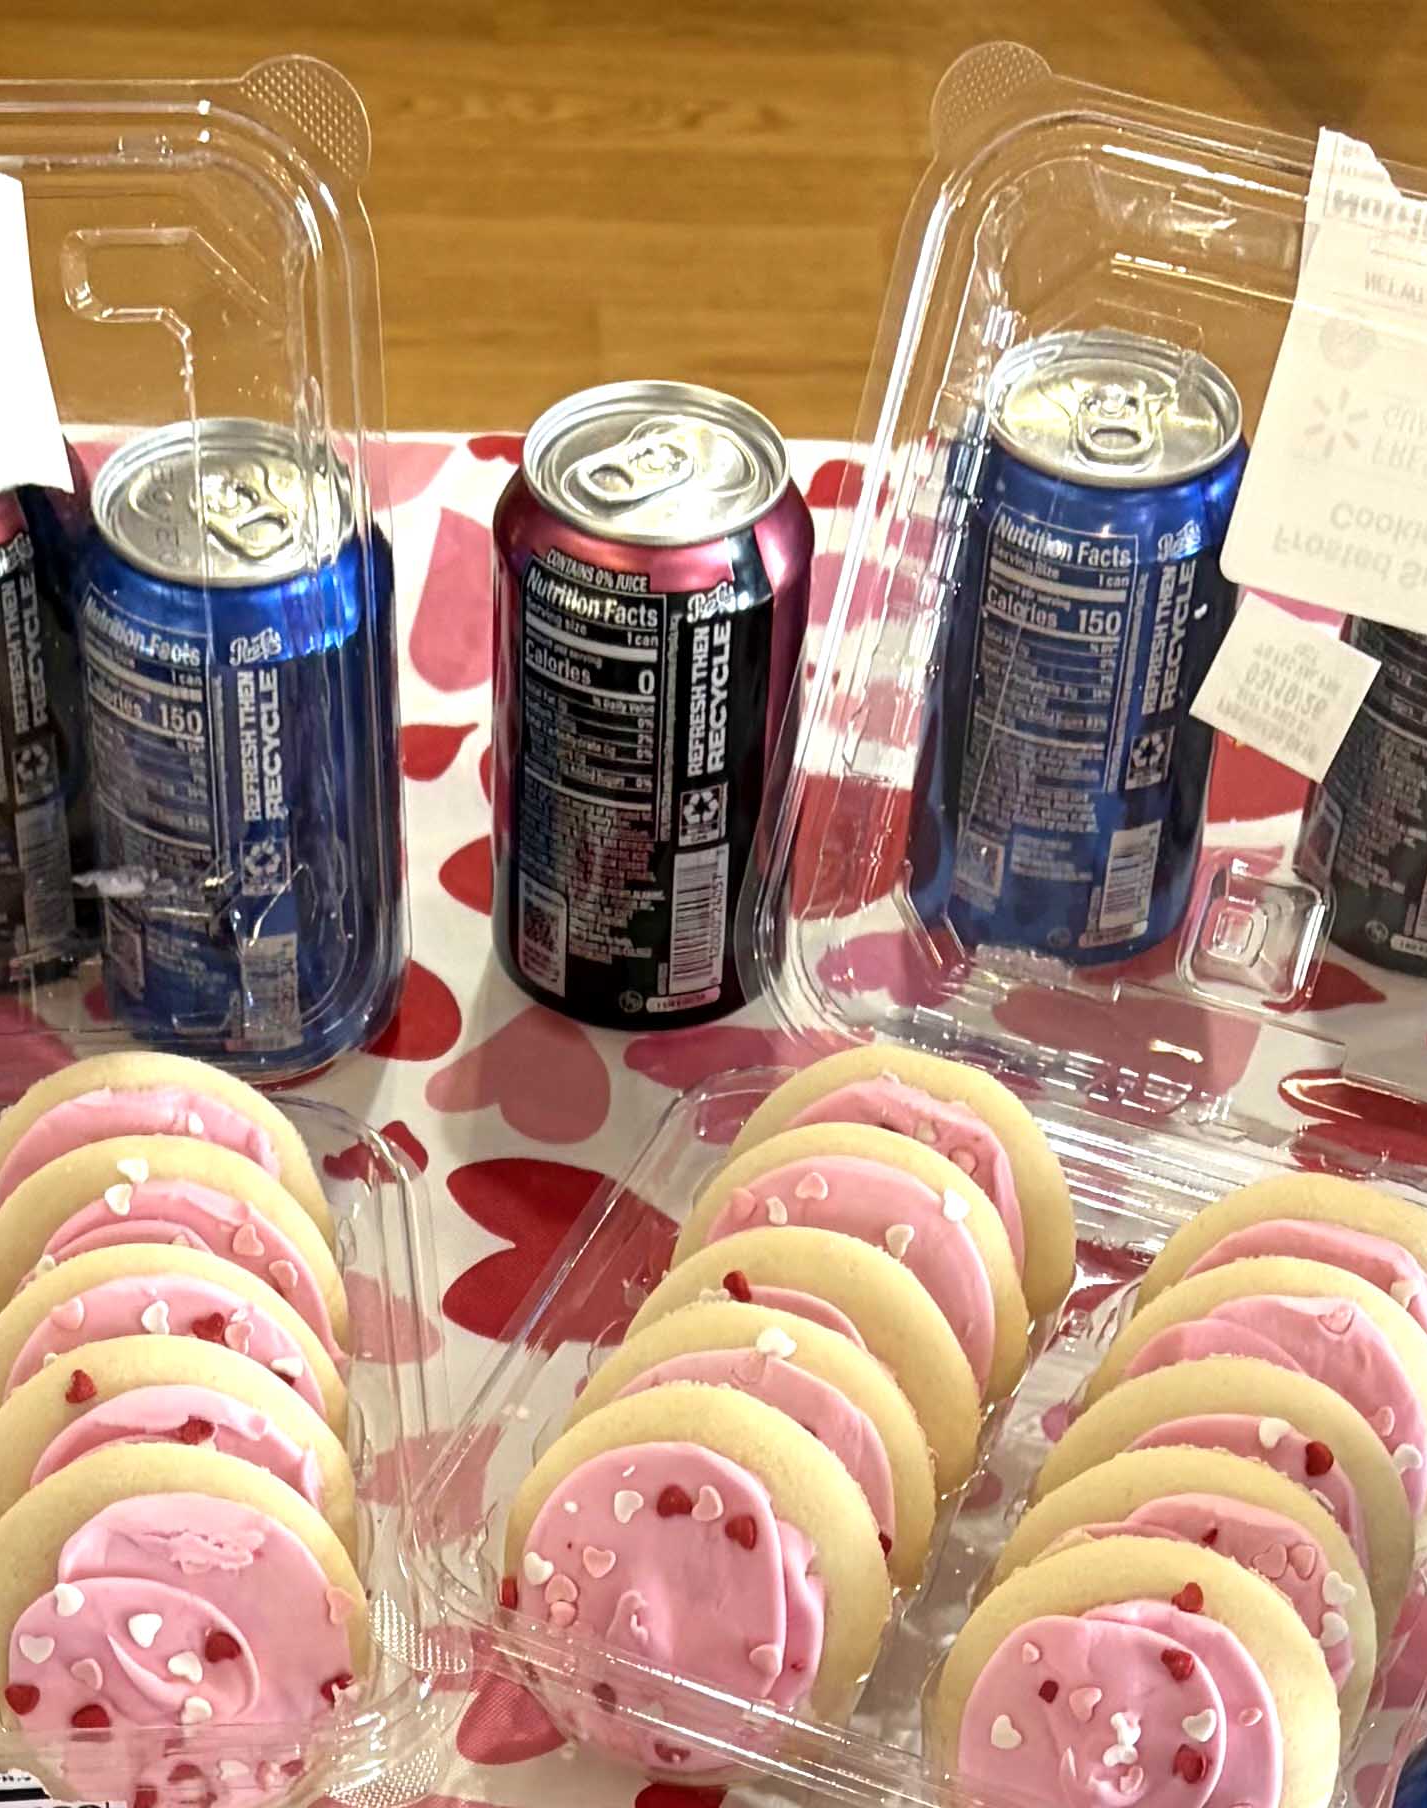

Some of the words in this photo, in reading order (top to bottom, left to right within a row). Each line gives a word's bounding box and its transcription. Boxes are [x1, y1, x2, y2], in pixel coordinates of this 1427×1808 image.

[995, 512, 1073, 564] Nutrition
[1076, 540, 1133, 570] Facts
[526, 566, 601, 620] Nutrition
[603, 597, 658, 628] Facts
[615, 573, 648, 593] JUICE
[987, 584, 1059, 629] Calories
[1078, 608, 1122, 637] 150
[19, 571, 49, 728] RECYCLE
[689, 624, 711, 684] THEN
[1160, 558, 1198, 712] RECYCLE
[525, 637, 592, 686] Calories
[637, 668, 656, 696] 0
[707, 620, 733, 774] RECYCLE
[158, 703, 204, 735] 150
[236, 670, 258, 728] THEN
[259, 667, 286, 821] RECYCLE
[687, 685, 708, 778] REFRESH
[240, 729, 262, 822] REFRESH
